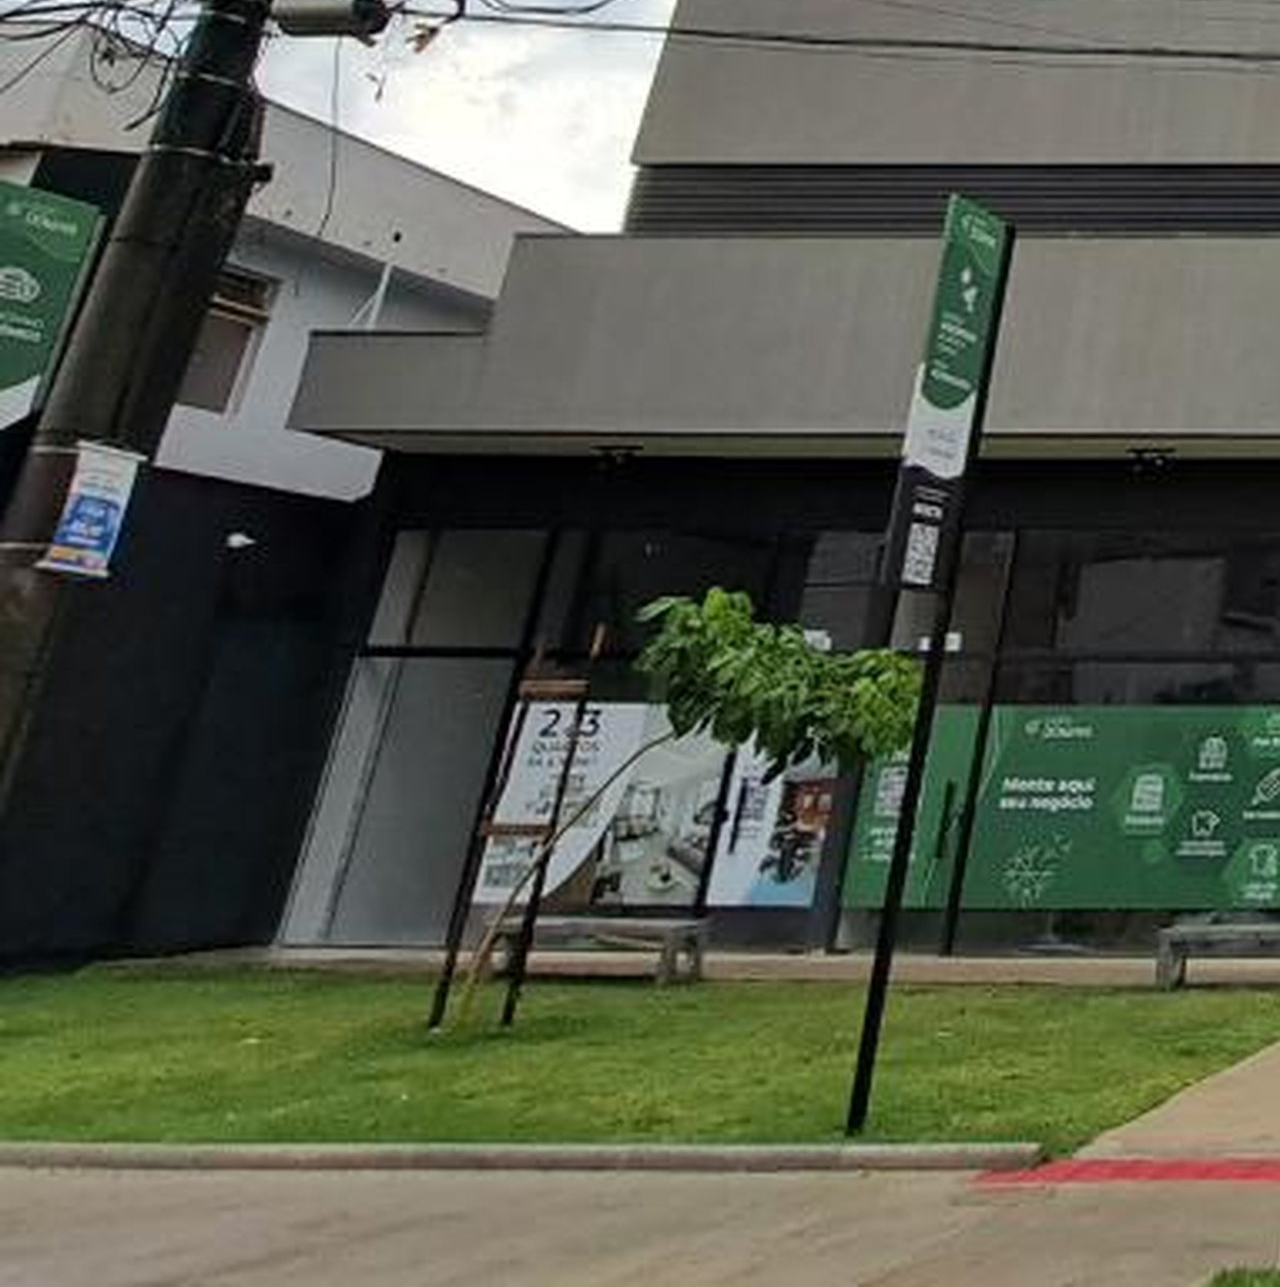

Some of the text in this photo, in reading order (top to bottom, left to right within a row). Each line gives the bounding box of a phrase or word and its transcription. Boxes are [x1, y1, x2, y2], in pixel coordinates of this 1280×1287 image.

[1058, 777, 1096, 794] aqui
[1000, 794, 1094, 813] seu negócio
